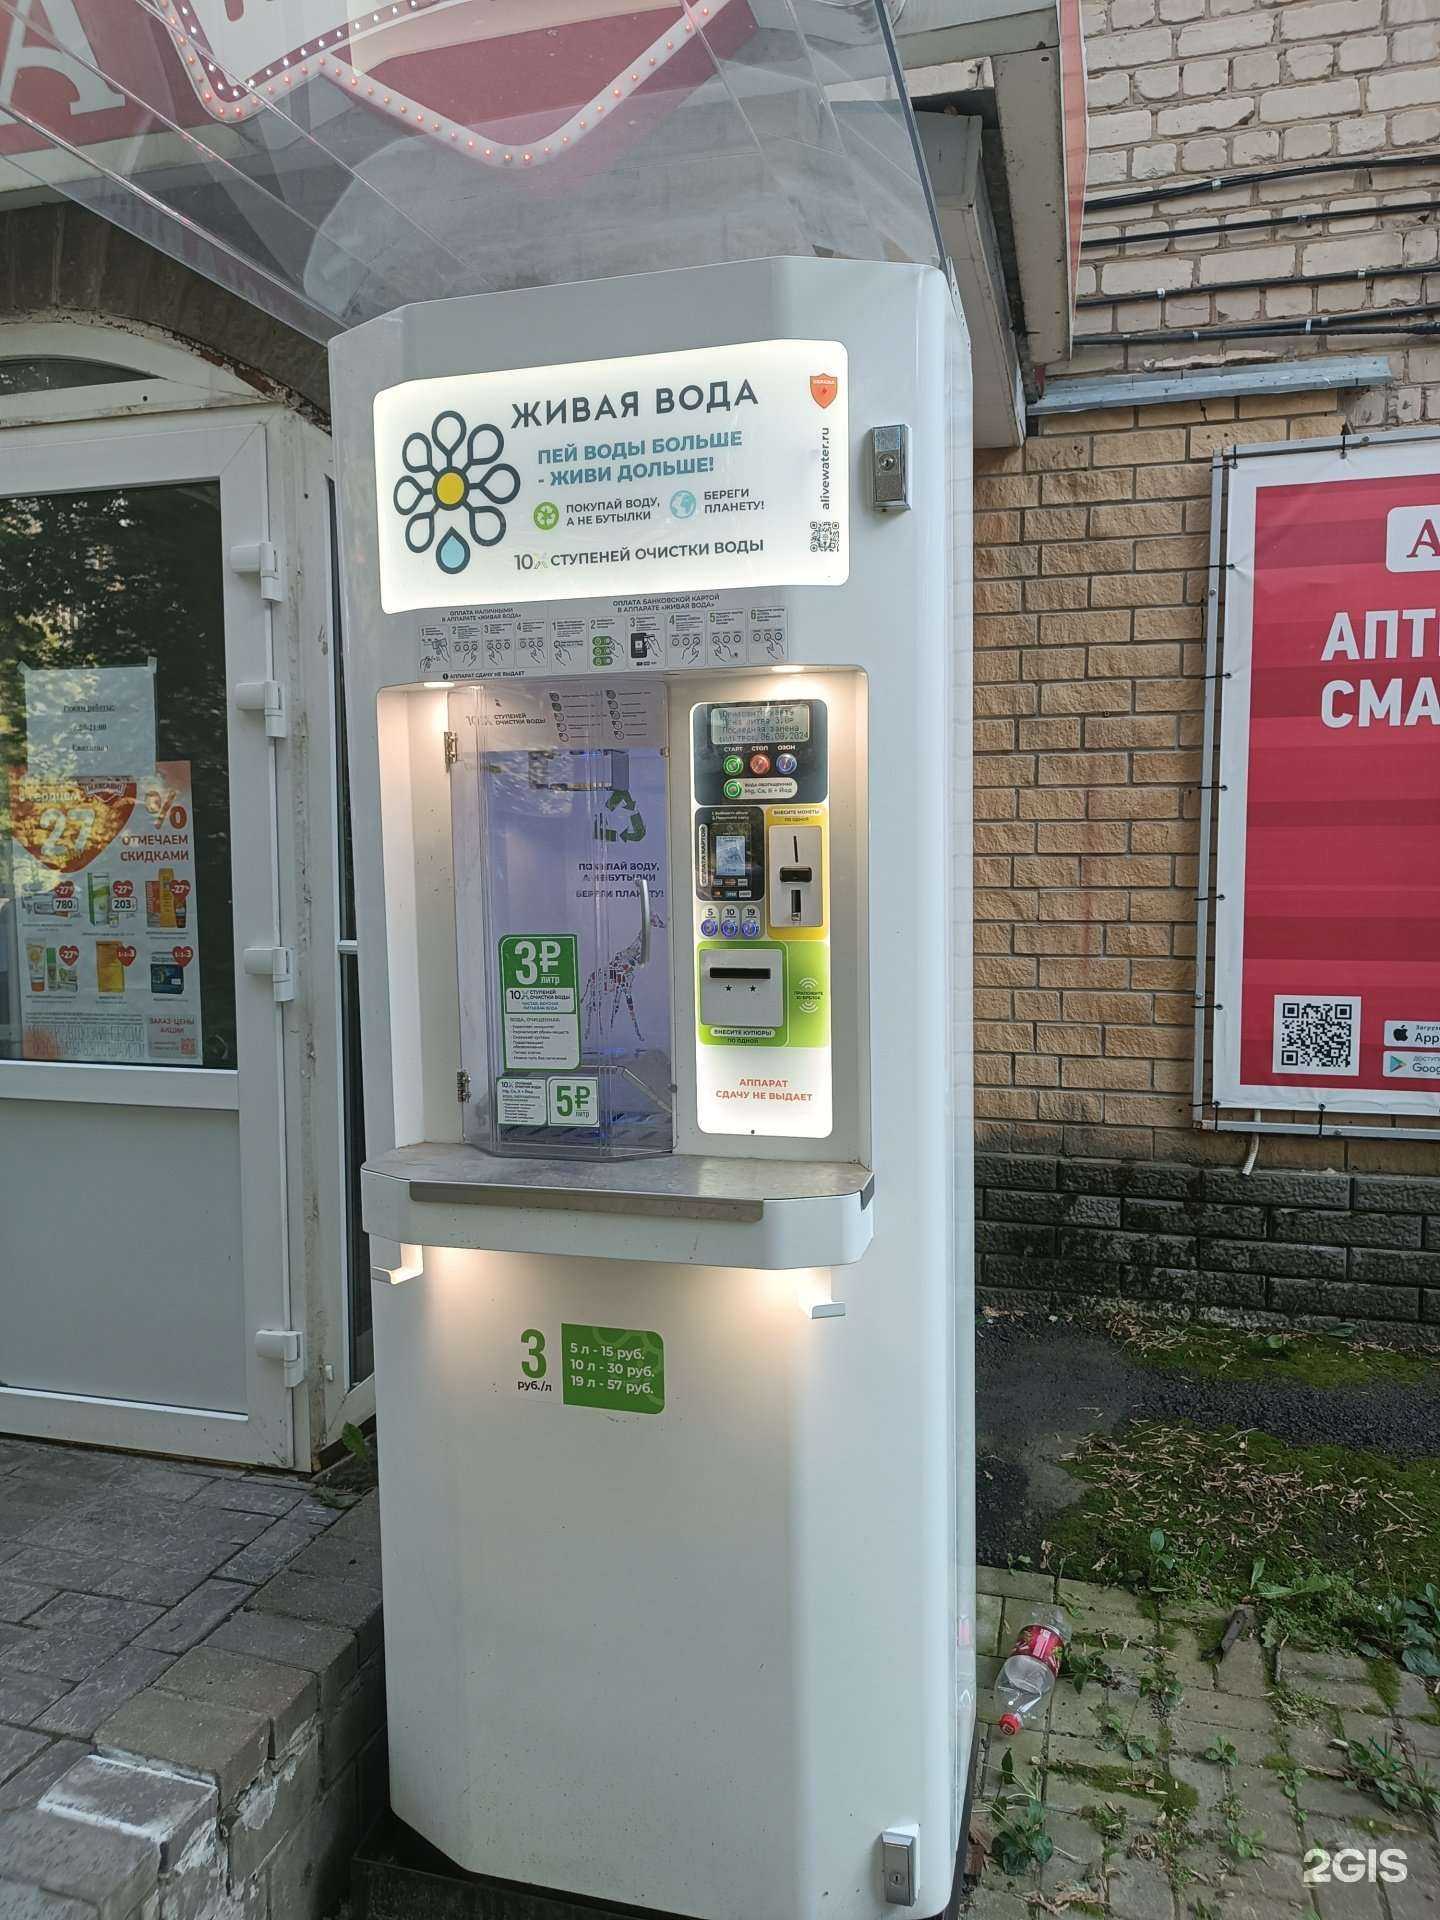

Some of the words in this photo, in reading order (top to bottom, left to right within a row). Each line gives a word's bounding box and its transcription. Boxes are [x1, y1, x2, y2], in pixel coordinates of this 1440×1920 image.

[511, 390, 639, 429] ЖИВАЯ
[656, 378, 759, 413] ВОДА
[537, 443, 577, 465] ПЕЙ
[584, 439, 646, 461] ВОДЫ
[652, 431, 743, 455] БОЛЬШЕ
[550, 465, 612, 486] ЖИВИ
[617, 456, 715, 483] ДОЛЬШЕ!
[820, 427, 831, 510] alivewater.ru
[704, 488, 750, 501] БЕРЕГИ
[566, 498, 623, 514] ПОКУПАЙ
[625, 496, 661, 511] ВОДУ,
[704, 499, 765, 515] ПЛАНЕТУ!
[566, 516, 575, 526] А
[577, 514, 597, 526] НЕ
[598, 511, 651, 525] БУТЫЛКИ
[514, 553, 534, 571] 10
[550, 548, 631, 567] СТУПЕНЕЙ
[635, 543, 709, 561] ОЧИСТКИ
[714, 539, 764, 555] ВОДЫ
[709, 612, 716, 623] 5
[750, 609, 757, 620] 6
[1320, 608, 1440, 661] АПТ
[39, 808, 96, 857] 27
[122, 834, 189, 846] ОТМЕЧАЕМ
[120, 850, 189, 863] СКИДКАМИ
[615, 889, 665, 898] ПЛАТУ!
[55, 900, 73, 910] 780
[114, 899, 131, 909] 203
[726, 908, 735, 916] 10
[746, 908, 756, 916] 19
[510, 990, 522, 1000] 10
[1414, 1032, 1440, 1045] App
[739, 1078, 789, 1088] АППАРАТ
[715, 1090, 750, 1099] СДАЧУ
[769, 1092, 813, 1102] ВЫДАЕТ
[520, 1328, 547, 1379] 3
[570, 1343, 578, 1354] 5
[581, 1346, 590, 1354] л
[601, 1346, 614, 1357] 15
[617, 1348, 645, 1361] руб.
[570, 1359, 584, 1370] 10
[586, 1362, 596, 1371] л
[607, 1363, 624, 1374] 30
[627, 1366, 655, 1378] руб.
[517, 1380, 552, 1392] руб./л
[570, 1375, 584, 1386] 19
[586, 1379, 596, 1388] л
[607, 1380, 623, 1390] 57
[626, 1383, 654, 1395] руб.
